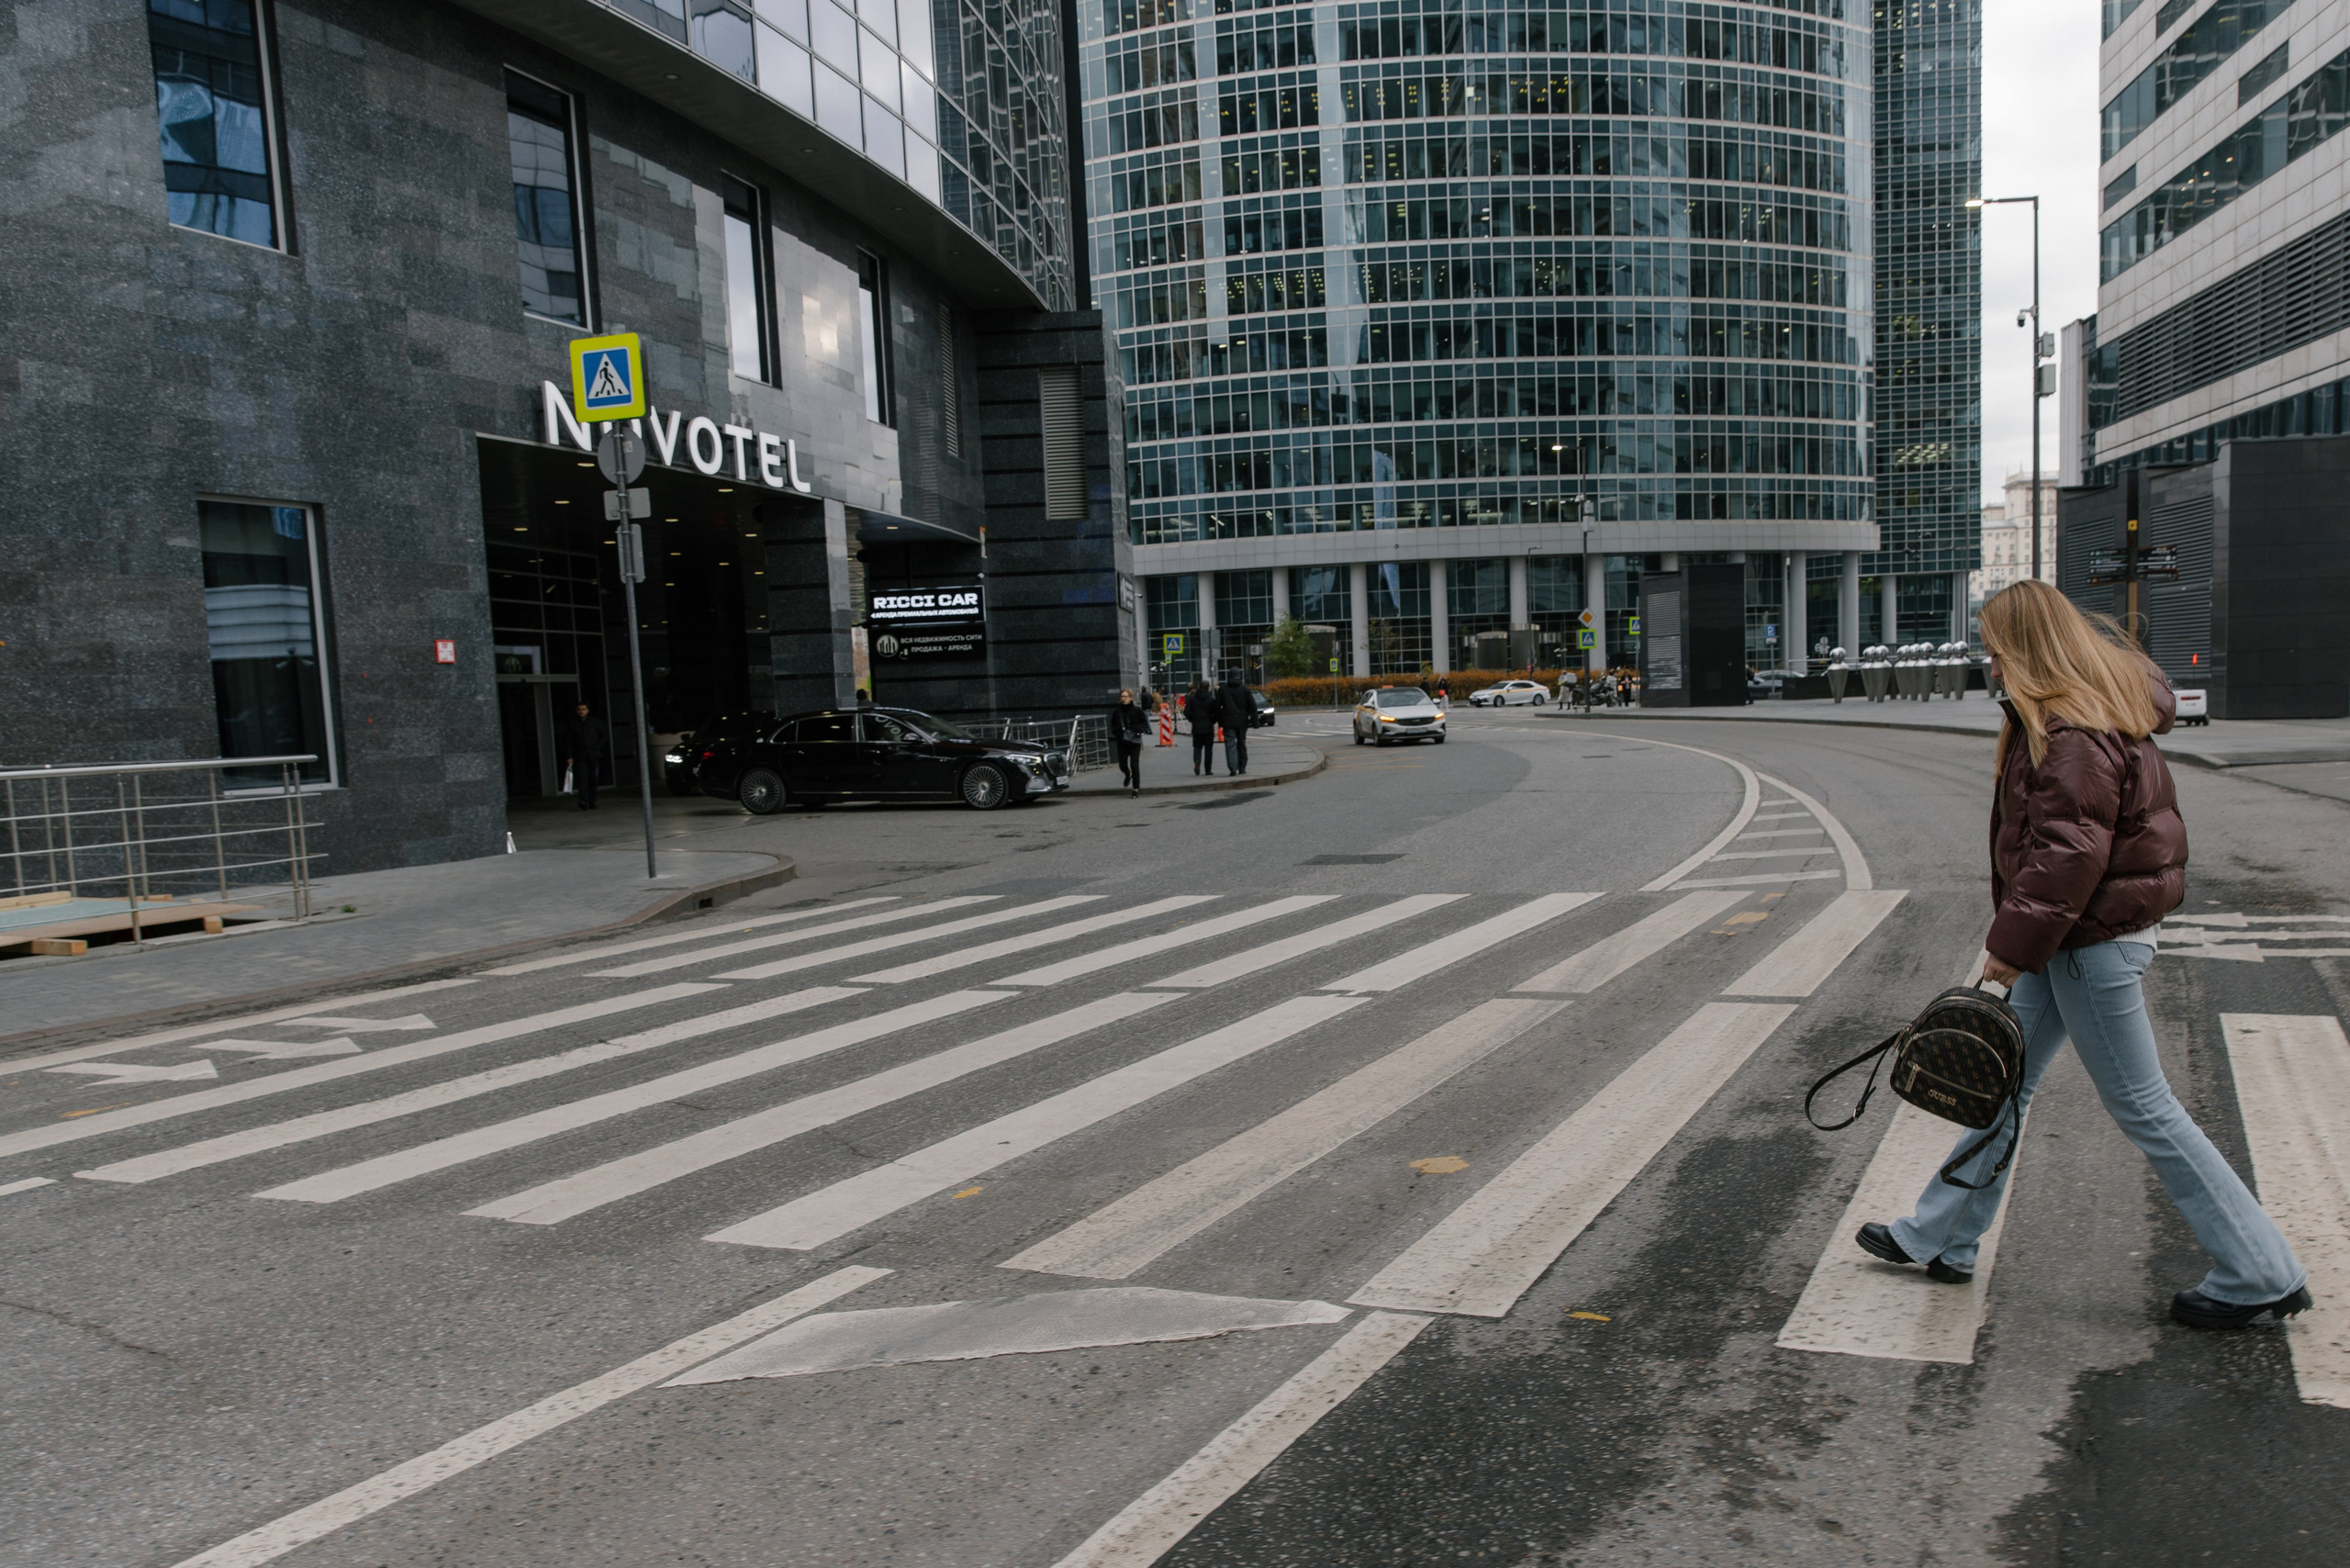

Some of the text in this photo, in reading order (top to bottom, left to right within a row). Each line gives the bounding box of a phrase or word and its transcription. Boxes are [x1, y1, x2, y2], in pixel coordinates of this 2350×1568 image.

[543, 380, 811, 493] NVOTEL
[873, 593, 979, 610] RICCI CAR
[875, 607, 979, 619] АРЕНДА ПРЕМИАЛЬНЫХ АВТОМОБИЛЕЙ
[913, 635, 965, 644] НЕДВИЖИМОСТЬ
[1928, 1089, 1957, 1107] GUESS
